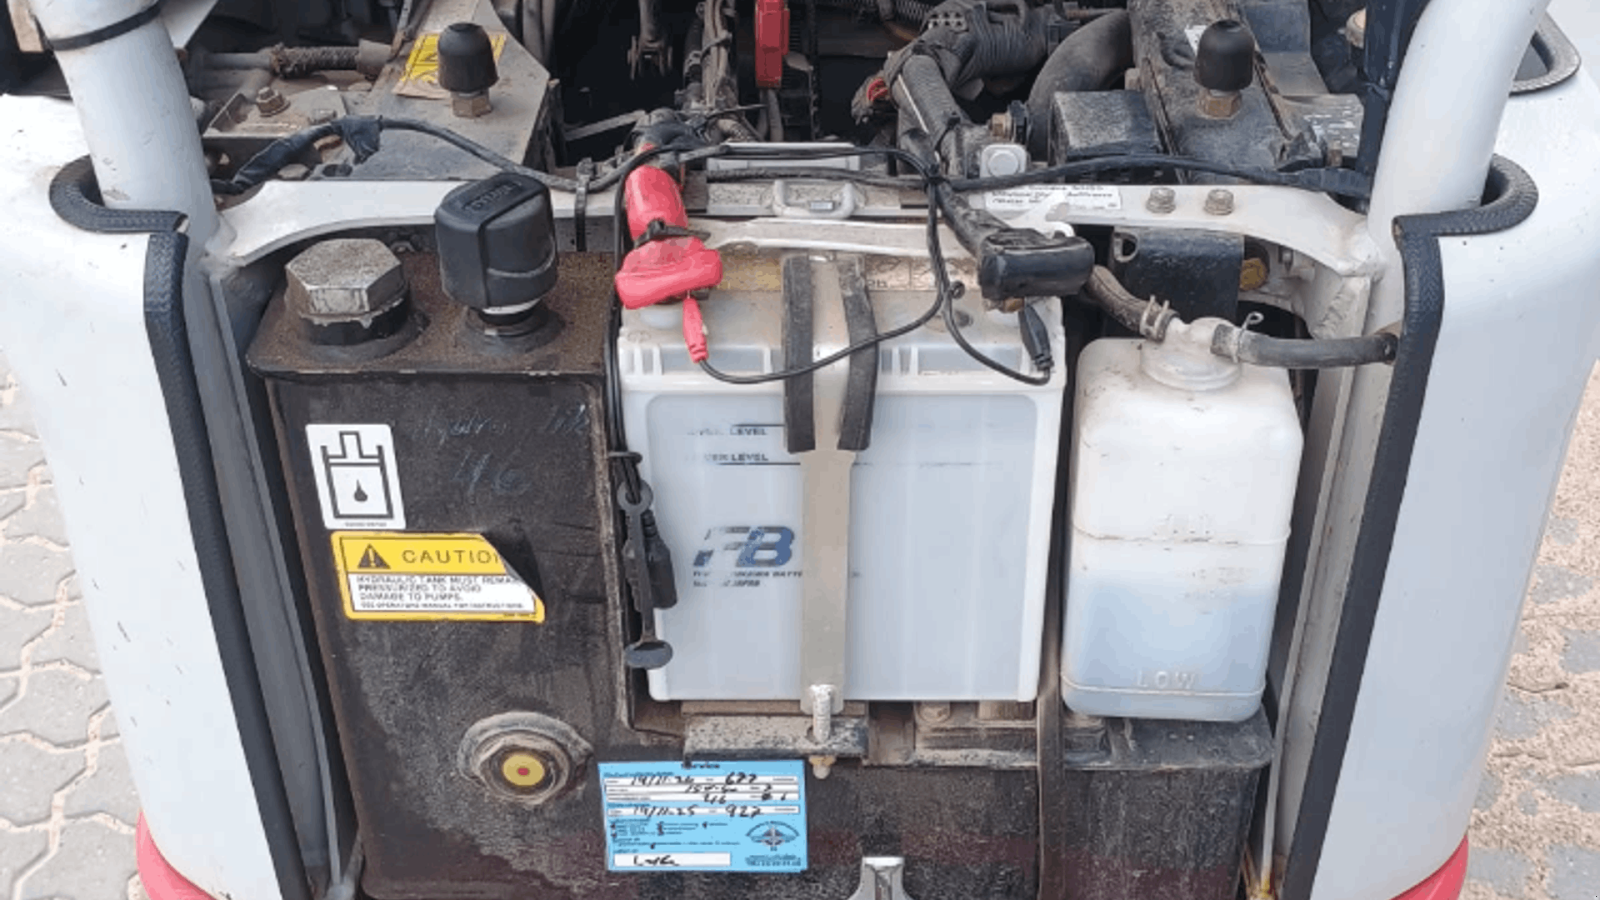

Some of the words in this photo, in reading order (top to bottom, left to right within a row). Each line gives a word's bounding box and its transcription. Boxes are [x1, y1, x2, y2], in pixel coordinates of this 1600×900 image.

[731, 453, 769, 461] LEVEL
[356, 575, 417, 584] HYDRAULIC
[419, 576, 447, 584] TANK
[450, 576, 478, 584] MUST
[358, 584, 429, 593] PRESSURIZED
[432, 585, 447, 593] TO
[450, 585, 482, 593] AVOID
[407, 593, 422, 601] TO
[1137, 671, 1196, 689] LOW
